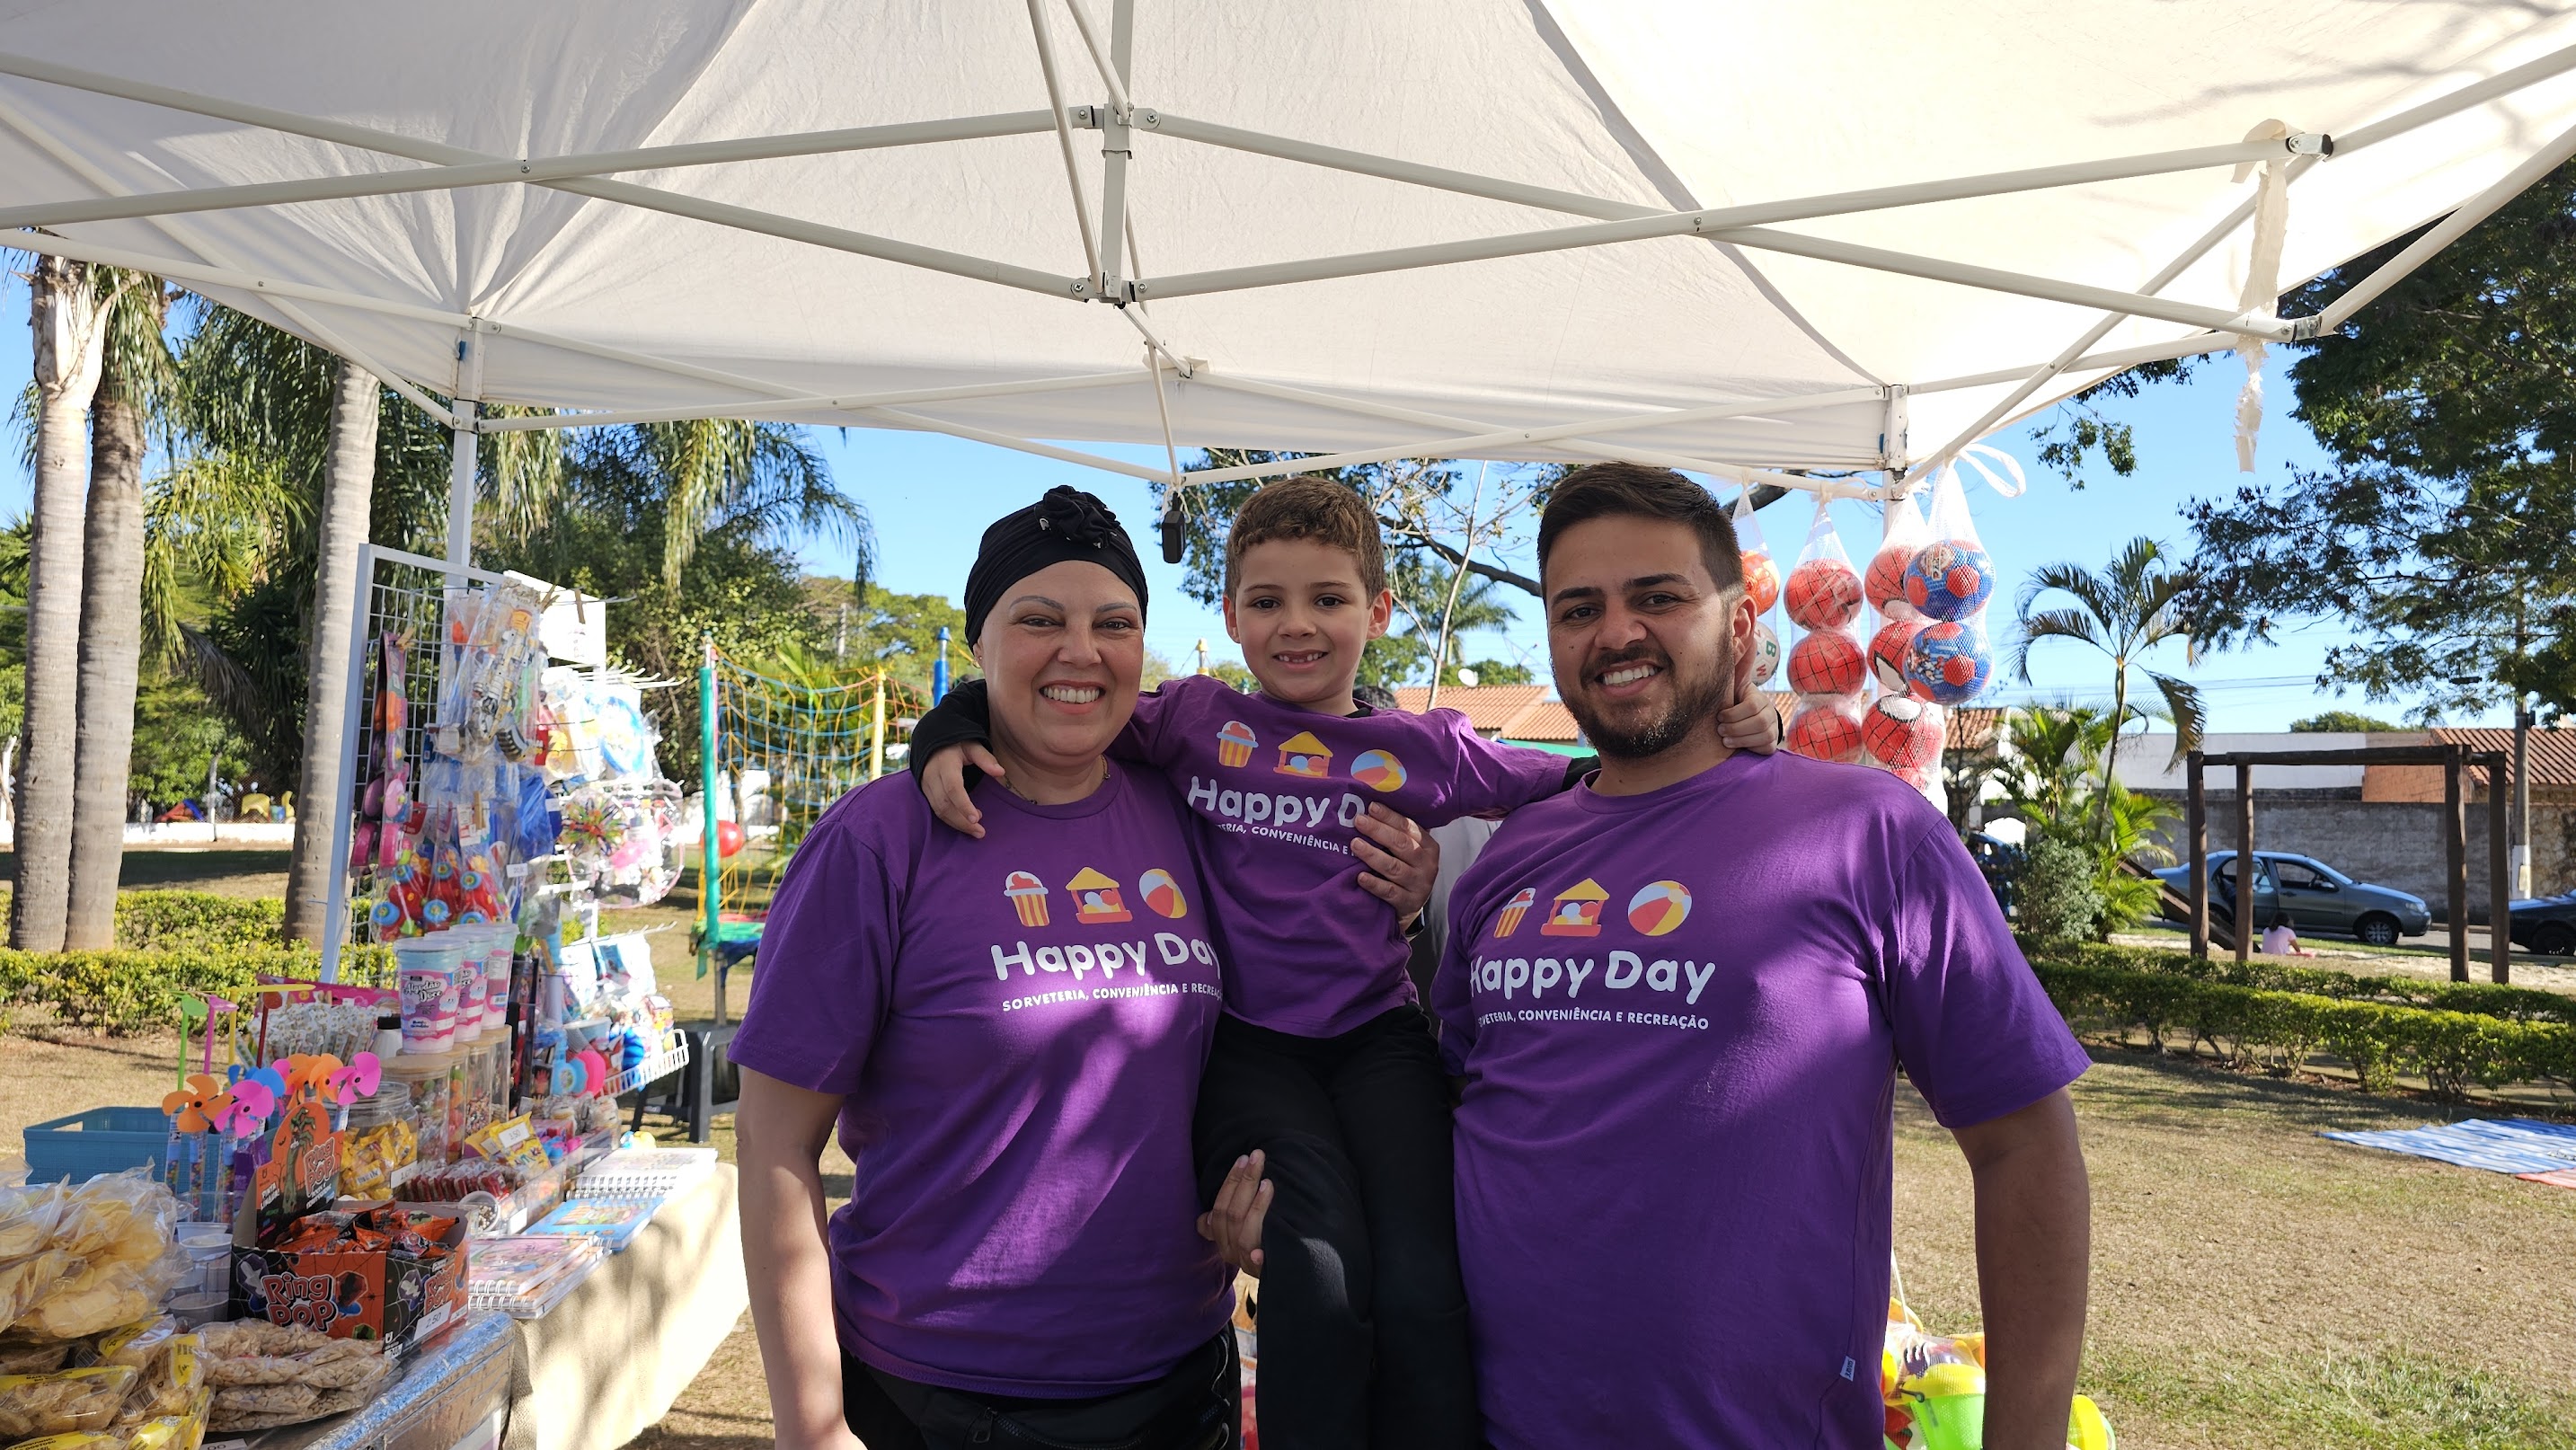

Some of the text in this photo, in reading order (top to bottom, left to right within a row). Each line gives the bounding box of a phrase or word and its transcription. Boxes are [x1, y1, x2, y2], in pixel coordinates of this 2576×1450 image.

[1187, 775, 1331, 828] Happy
[1251, 825, 1340, 853] CONVENIÊNCIA
[1342, 844, 1349, 854] E
[990, 932, 1221, 981] Happy Day
[1470, 950, 1716, 1005] Happy Day
[1002, 989, 1089, 1012] SORVETERIA,
[1093, 982, 1179, 1000] CONVENIÊNCIA
[1182, 983, 1188, 994] E
[1518, 1006, 1612, 1021] CONVENIÊNCIA
[1616, 1011, 1623, 1022] E
[1627, 1012, 1709, 1030] RECREAÇÃO
[261, 1271, 335, 1307] Ring
